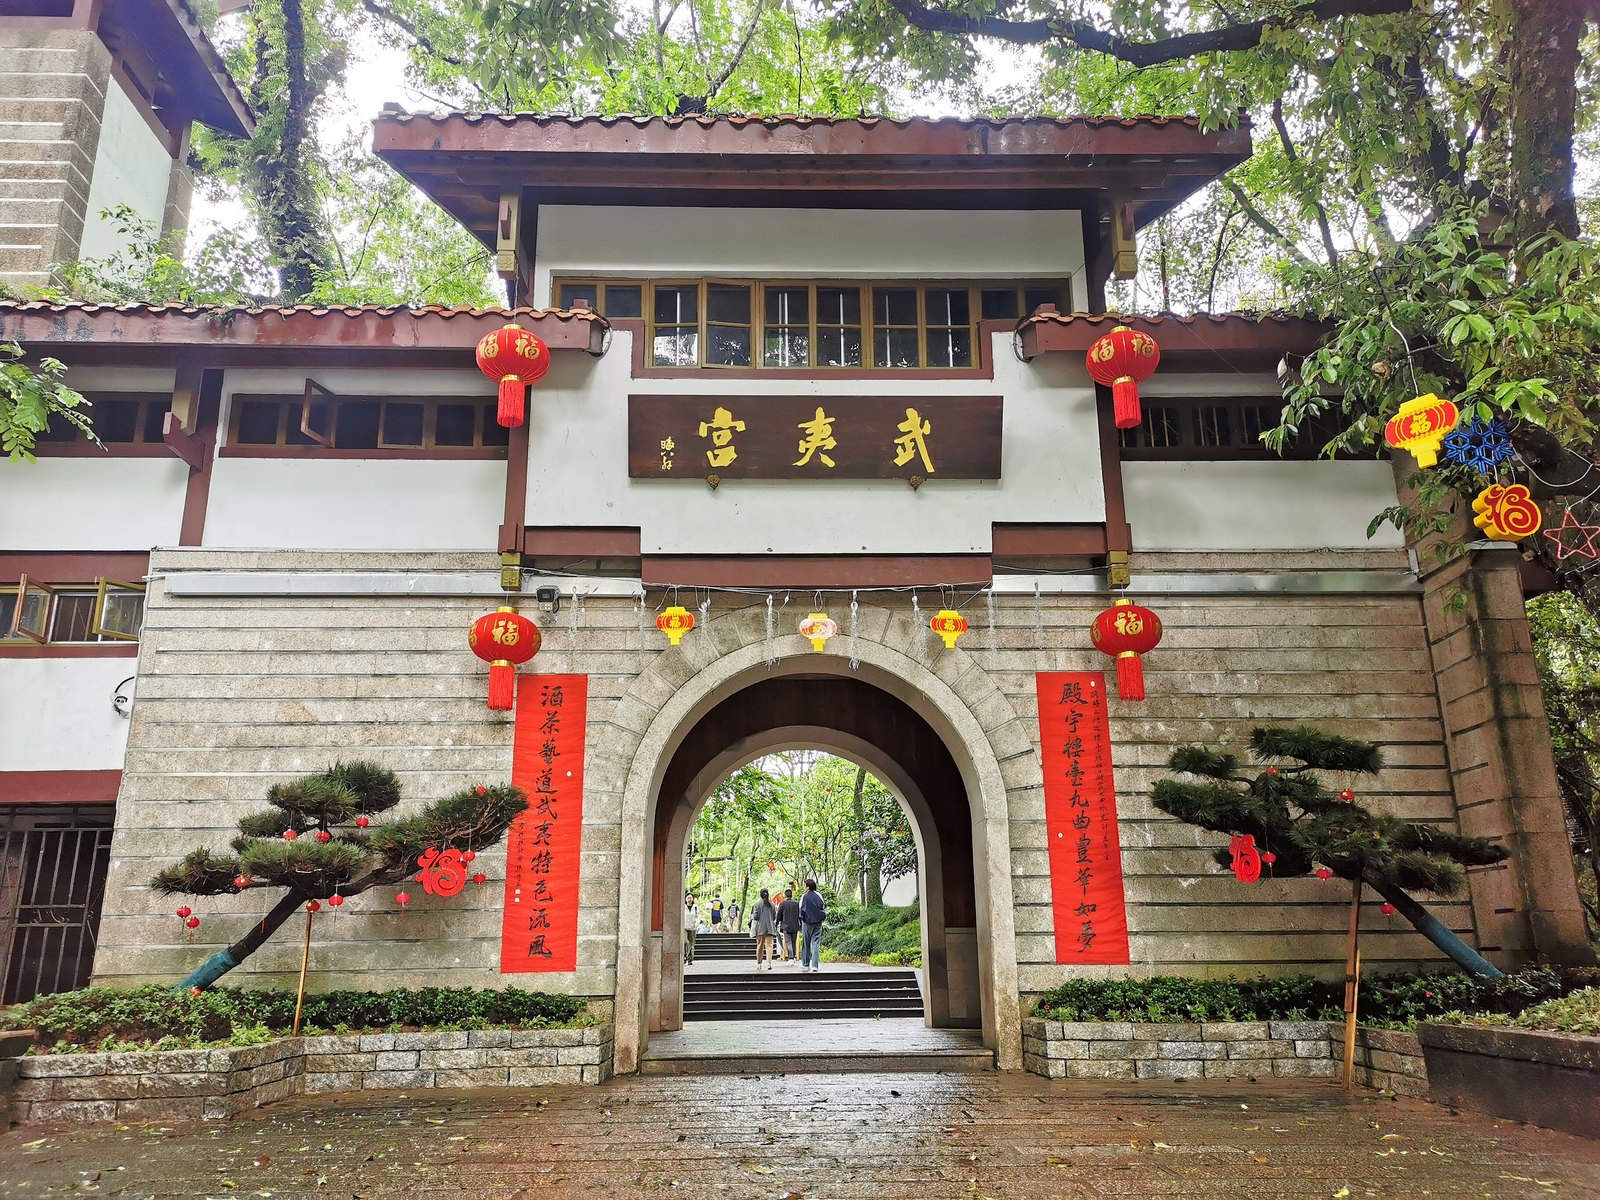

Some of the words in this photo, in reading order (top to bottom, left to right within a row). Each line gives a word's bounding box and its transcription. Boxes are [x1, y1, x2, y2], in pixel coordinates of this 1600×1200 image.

[478, 333, 499, 360] 福
[515, 332, 541, 360] 福
[1090, 338, 1115, 363] 福
[1132, 333, 1155, 358] 福
[1409, 412, 1432, 436] 福
[1482, 484, 1541, 537] 福
[492, 620, 520, 646] 福
[1114, 611, 1143, 636] 福
[415, 846, 469, 898] 福
